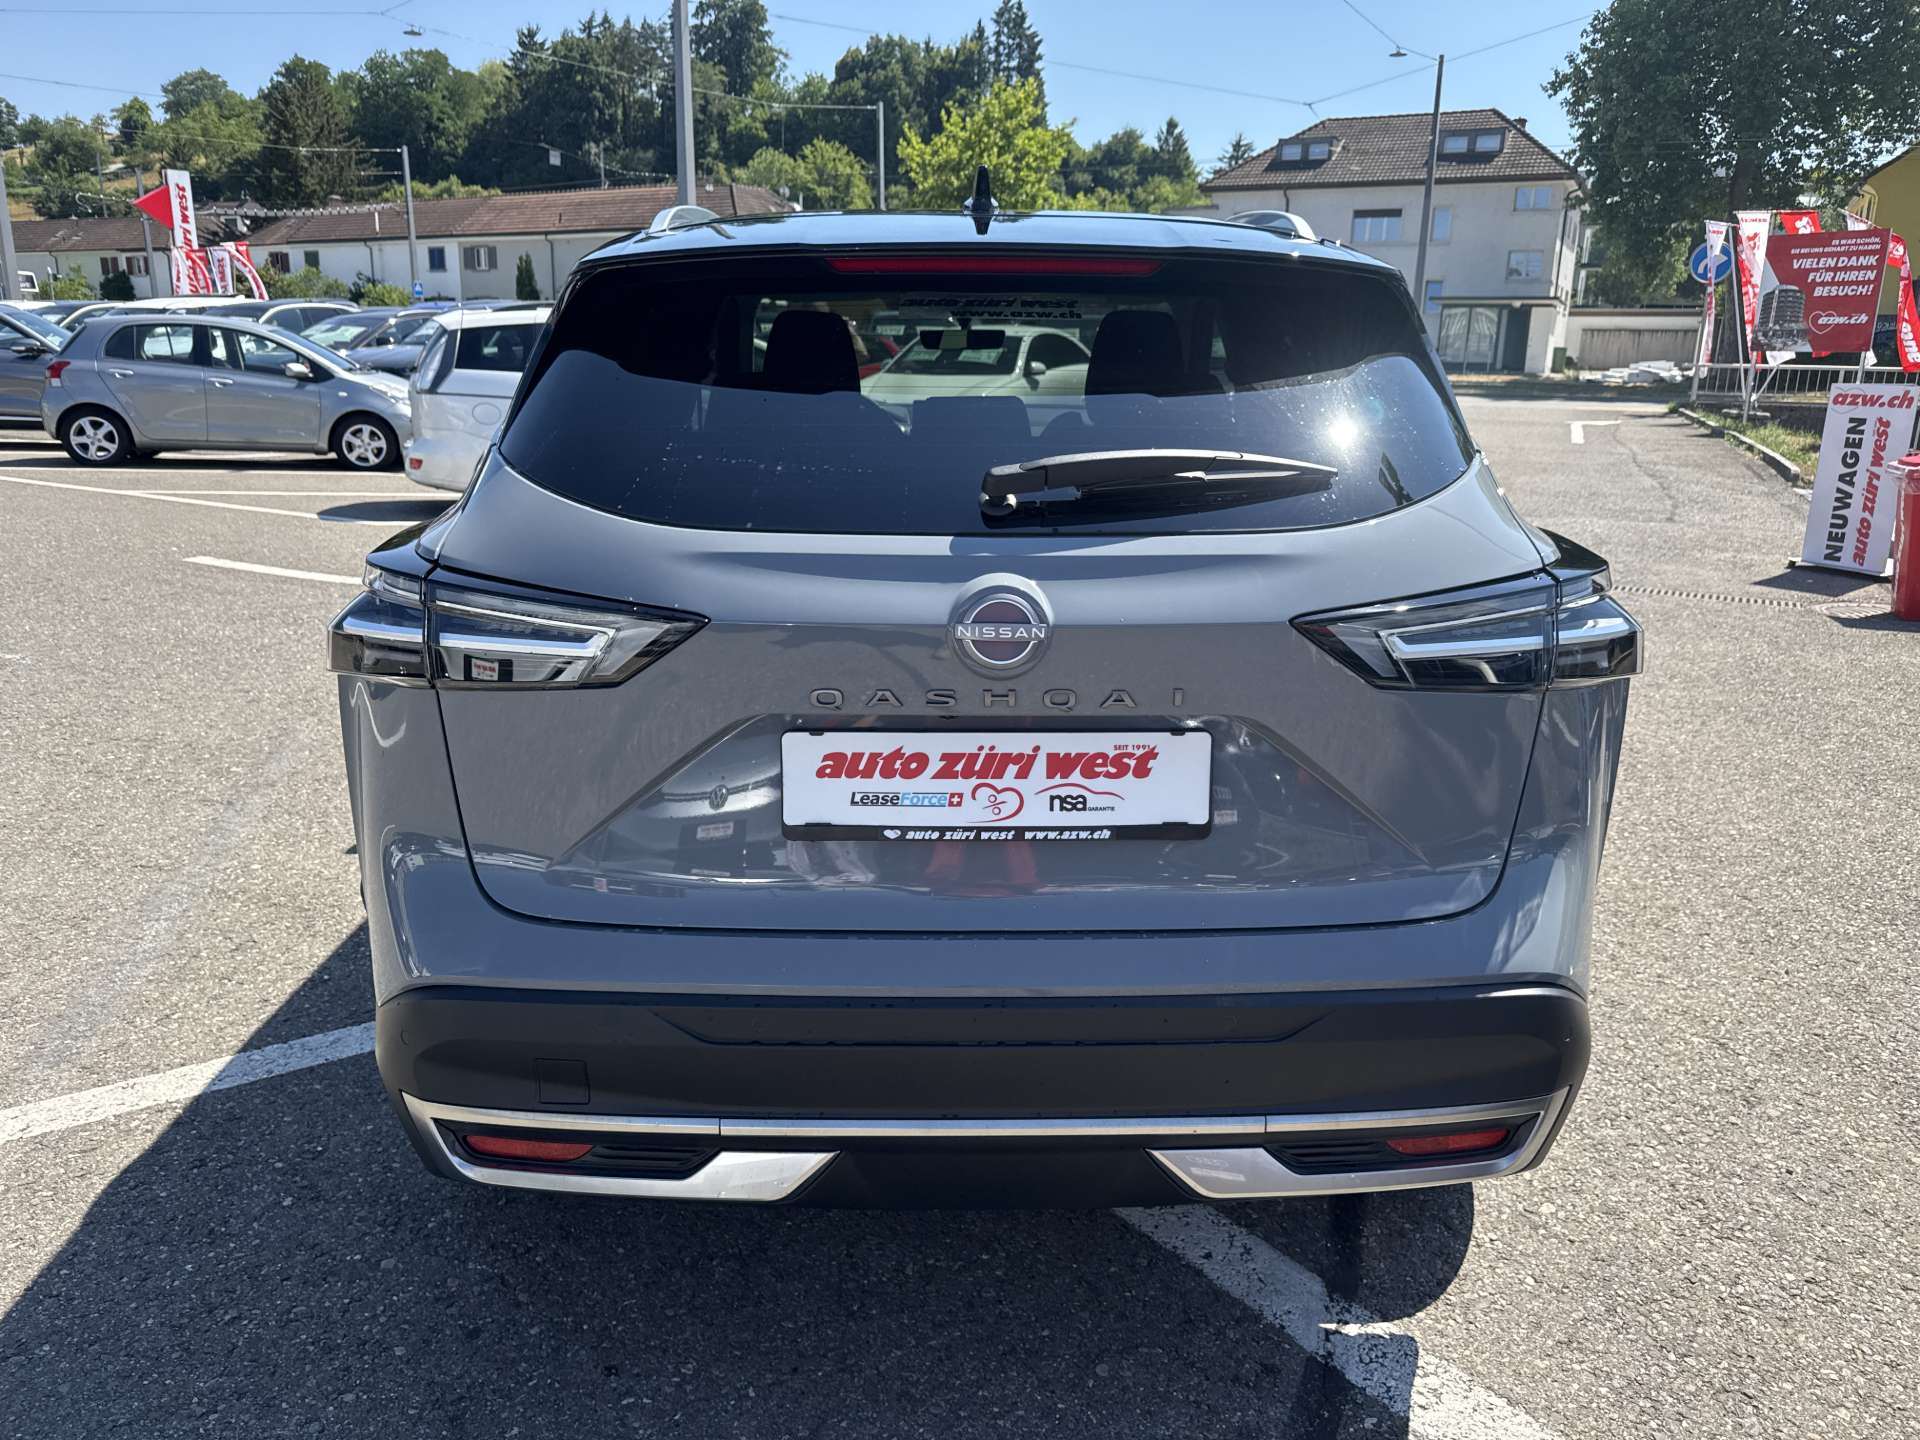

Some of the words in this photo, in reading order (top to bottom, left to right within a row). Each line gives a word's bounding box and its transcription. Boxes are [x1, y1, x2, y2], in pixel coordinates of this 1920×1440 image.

[175, 183, 190, 224] west
[1792, 257, 1838, 270] VIELEN
[1837, 255, 1880, 268] DANK
[1807, 269, 1835, 283] FÜR
[1835, 269, 1878, 282] IHREN
[1813, 284, 1875, 297] BESUCH!
[950, 309, 1082, 319] www.azw.ch
[1817, 312, 1870, 325] azw.ch
[1832, 390, 1915, 409] azw.ch
[1870, 416, 1891, 468] west
[1823, 417, 1867, 562] NEUWAGEN
[1861, 468, 1881, 518] züri
[1852, 517, 1872, 567] auto
[956, 625, 1047, 640] NISSAN
[808, 687, 1186, 713] QASHQAI
[815, 745, 930, 780] auto
[930, 745, 1041, 780] züri
[1046, 745, 1160, 780] west
[850, 791, 948, 807] LeaseForce
[1049, 794, 1087, 812] nsa
[905, 830, 940, 840] auto
[943, 829, 977, 840] züri
[980, 830, 1016, 840] west
[1024, 829, 1112, 840] www.azw.ch
